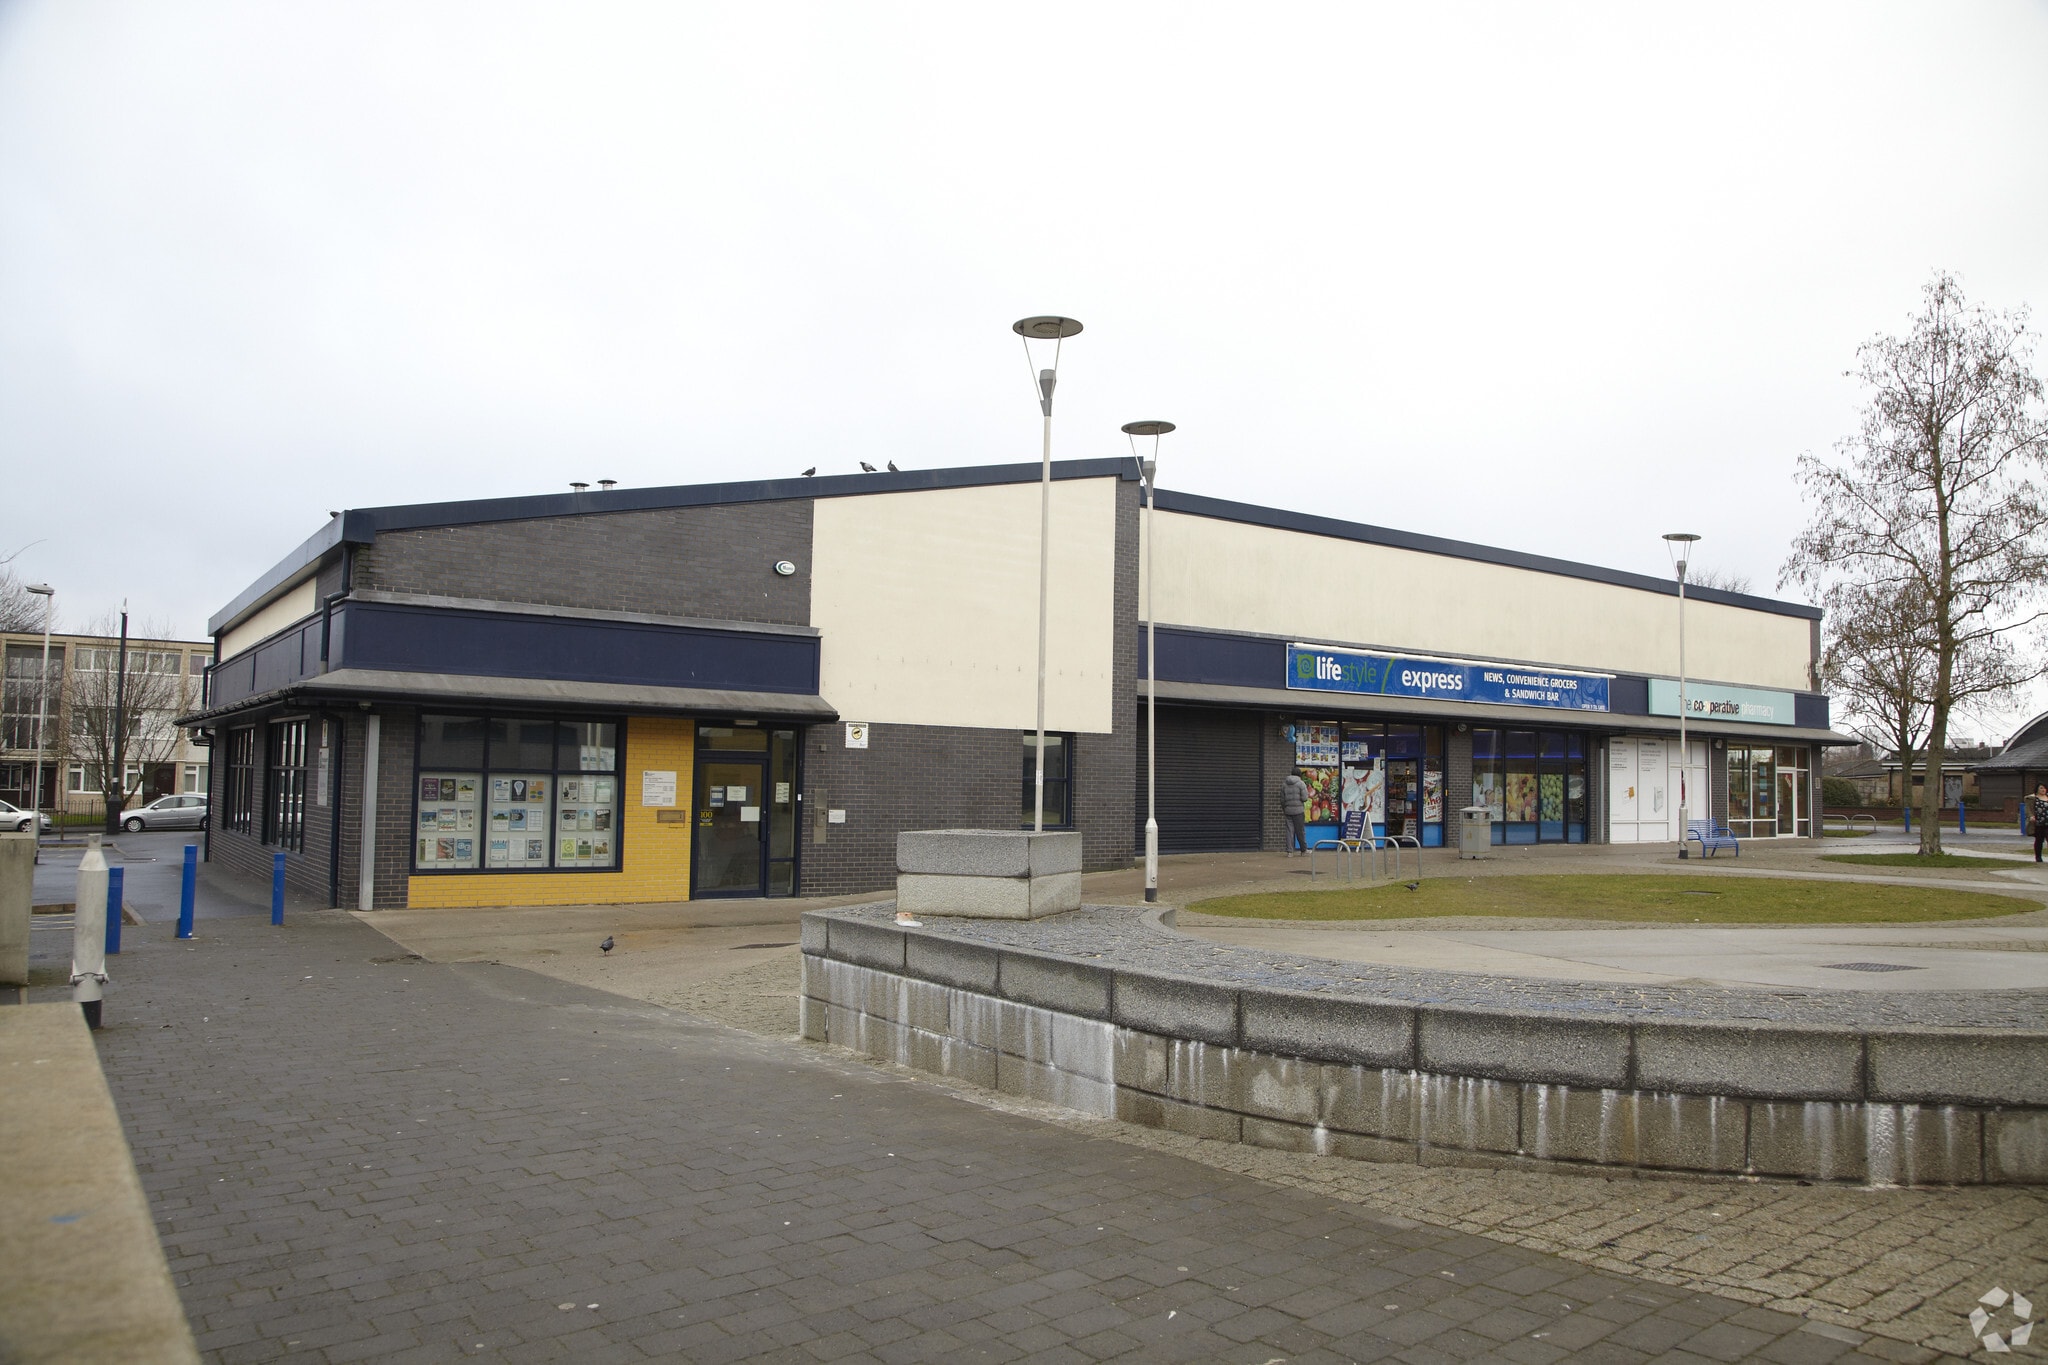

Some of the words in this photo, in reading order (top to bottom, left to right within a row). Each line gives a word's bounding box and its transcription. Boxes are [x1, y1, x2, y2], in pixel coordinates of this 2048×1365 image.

[1316, 656, 1376, 687] lifestyle
[1401, 669, 1463, 693] express
[1483, 671, 1505, 685] NEWS,
[1506, 674, 1549, 687] CONVENIENCE
[1550, 679, 1578, 690] GROCERS
[1504, 688, 1511, 698] &
[1511, 688, 1545, 701] SANDWICH
[1546, 691, 1560, 702] BAR
[1741, 701, 1774, 720] pharmacy
